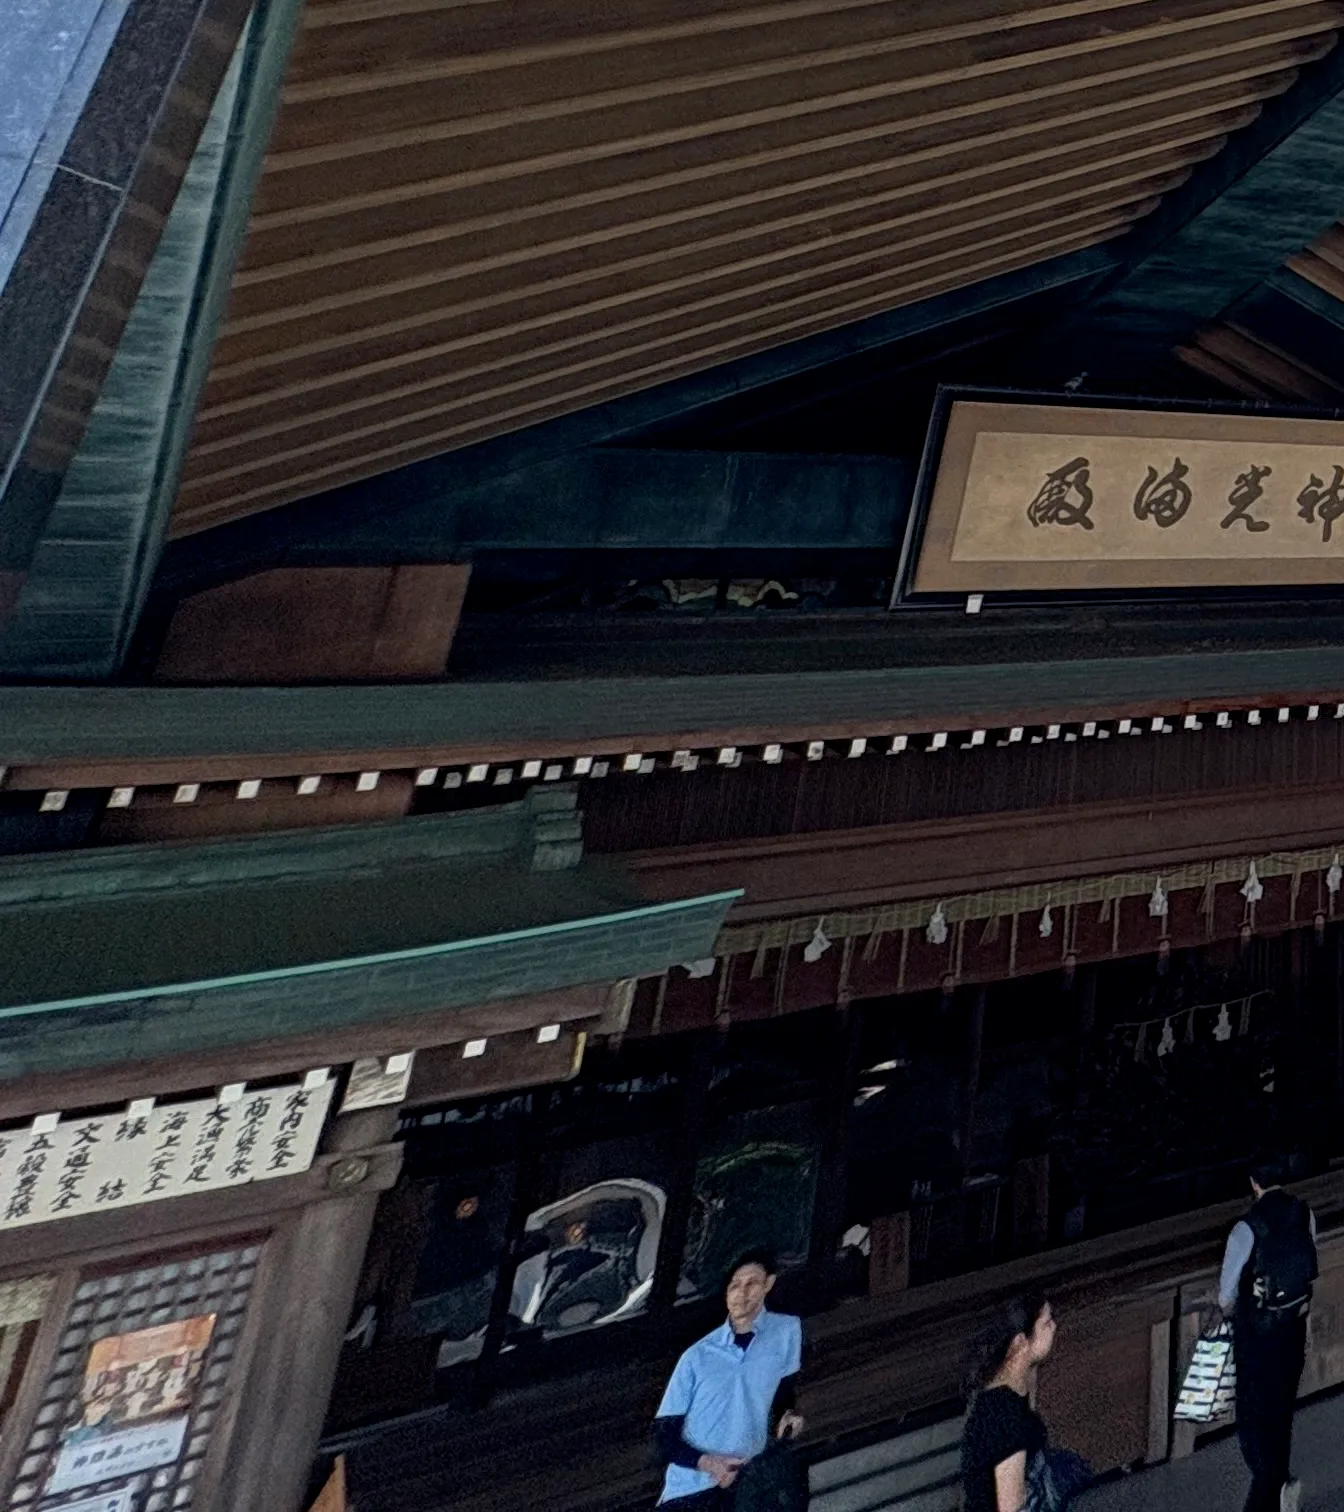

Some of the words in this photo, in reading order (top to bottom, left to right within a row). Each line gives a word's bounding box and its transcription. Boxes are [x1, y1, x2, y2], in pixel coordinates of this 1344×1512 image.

[143, 1111, 189, 1195] 海上安全
[265, 1089, 312, 1171] 家内安全
